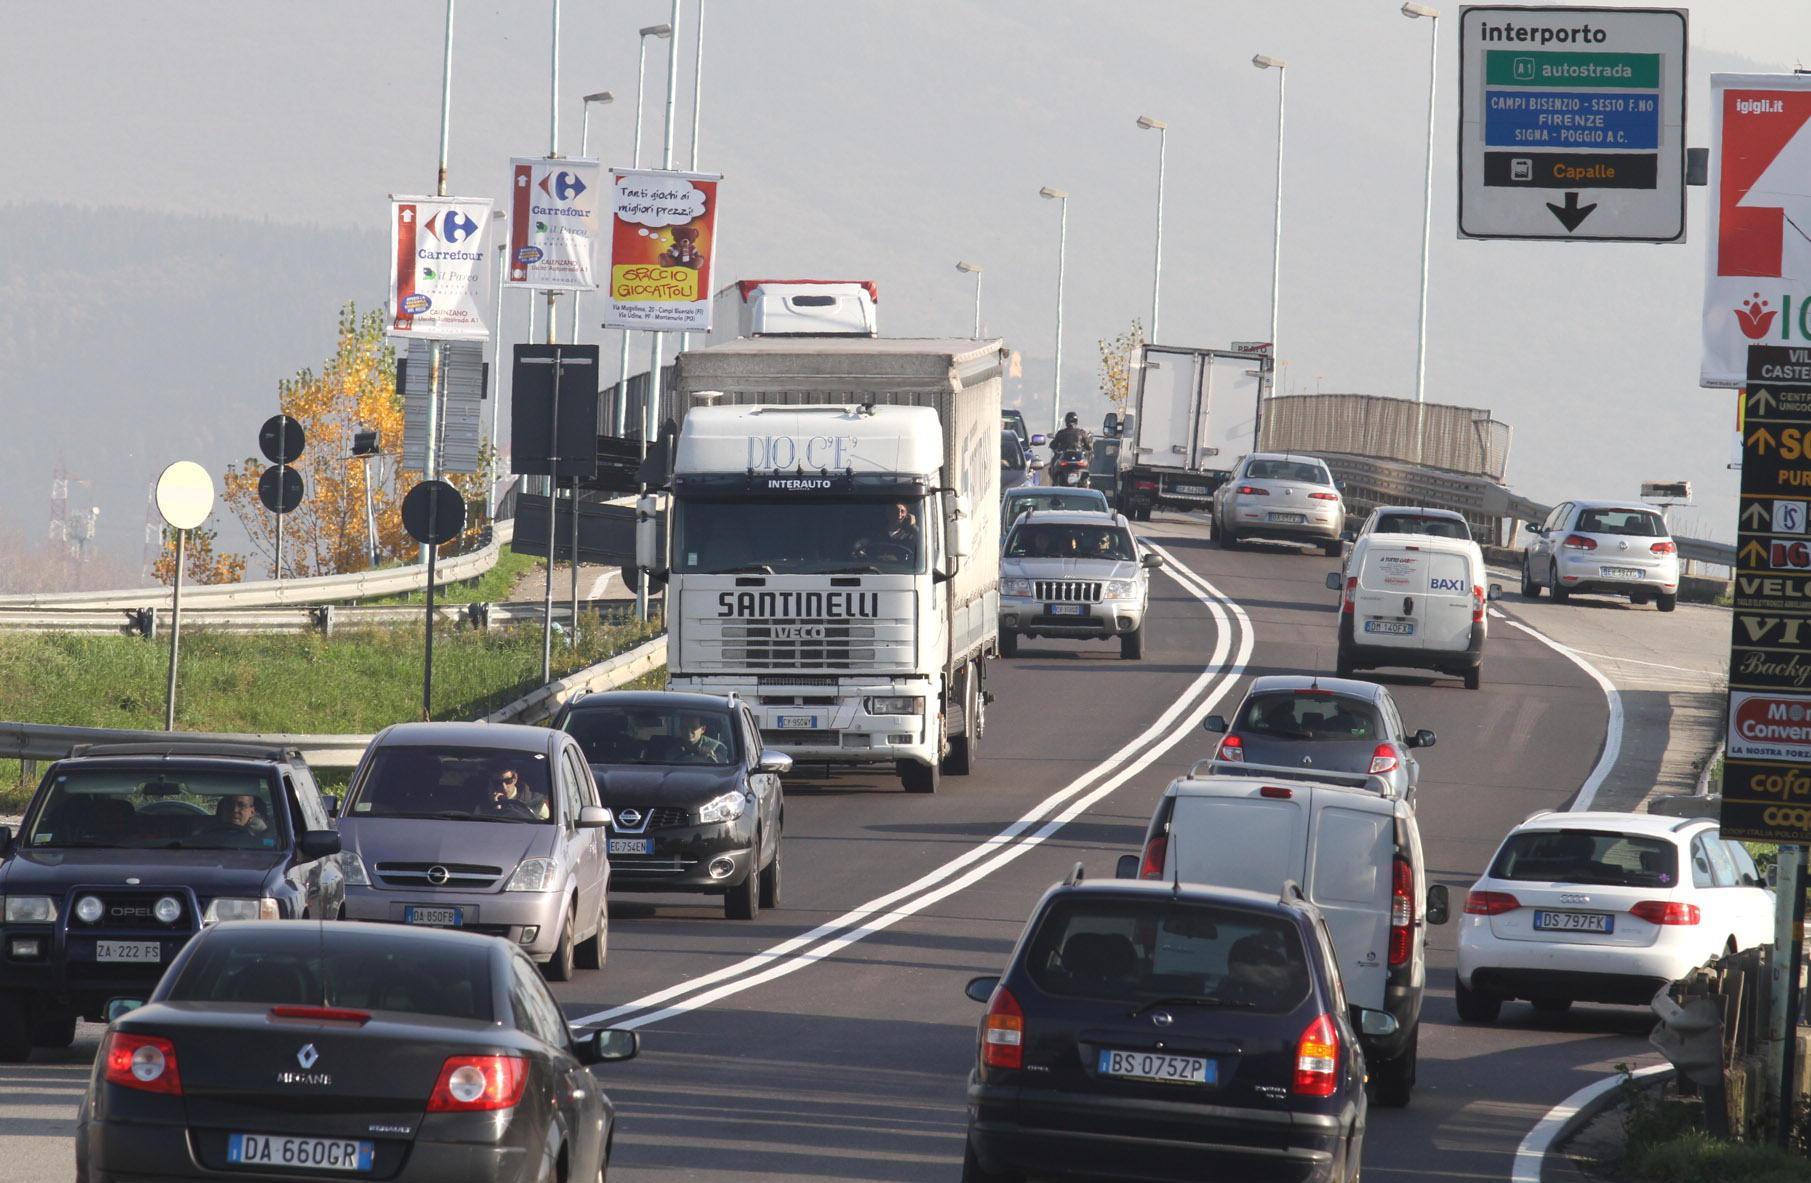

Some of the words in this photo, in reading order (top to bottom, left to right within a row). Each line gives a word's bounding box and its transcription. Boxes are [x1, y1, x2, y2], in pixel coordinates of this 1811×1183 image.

[1481, 22, 1608, 45] interporto
[1542, 62, 1632, 78] autostrada
[1491, 97, 1526, 110] CAMPI
[1529, 97, 1580, 111] BISENZIO
[1592, 99, 1624, 112] SESTO
[1628, 99, 1654, 113] F.NO
[1736, 98, 1784, 114] igigli.it
[1539, 114, 1605, 127] FIRENZE
[1515, 129, 1549, 142] SIGNA
[1561, 129, 1603, 143] POGGIO
[1606, 131, 1615, 143] A
[1617, 131, 1628, 143] C.
[1553, 163, 1615, 179] Capalle
[620, 187, 648, 197] Tanti
[650, 190, 678, 201] giochi
[680, 191, 690, 200] ai
[532, 205, 591, 218] Carrefour
[618, 203, 654, 215] migliori
[418, 248, 484, 261] Carrefour
[622, 267, 688, 282] SPACCIO
[768, 479, 831, 489] INTERAUTO
[1430, 578, 1464, 591] BAXI
[718, 592, 878, 618] SANTINELLI
[773, 626, 825, 639] IVECO
[1732, 746, 1743, 754] LA
[1786, 749, 1811, 758] FORZ
[111, 907, 153, 917] OPEL
[1543, 913, 1559, 927] DS
[1563, 914, 1604, 929] 797FK
[98, 945, 111, 958] ZA
[118, 945, 140, 958] 222
[145, 945, 159, 959] FS
[1111, 1052, 1135, 1073] BS
[1141, 1055, 1203, 1079] 075ZP
[243, 1136, 273, 1163] DA
[281, 1137, 358, 1167] 660GR
